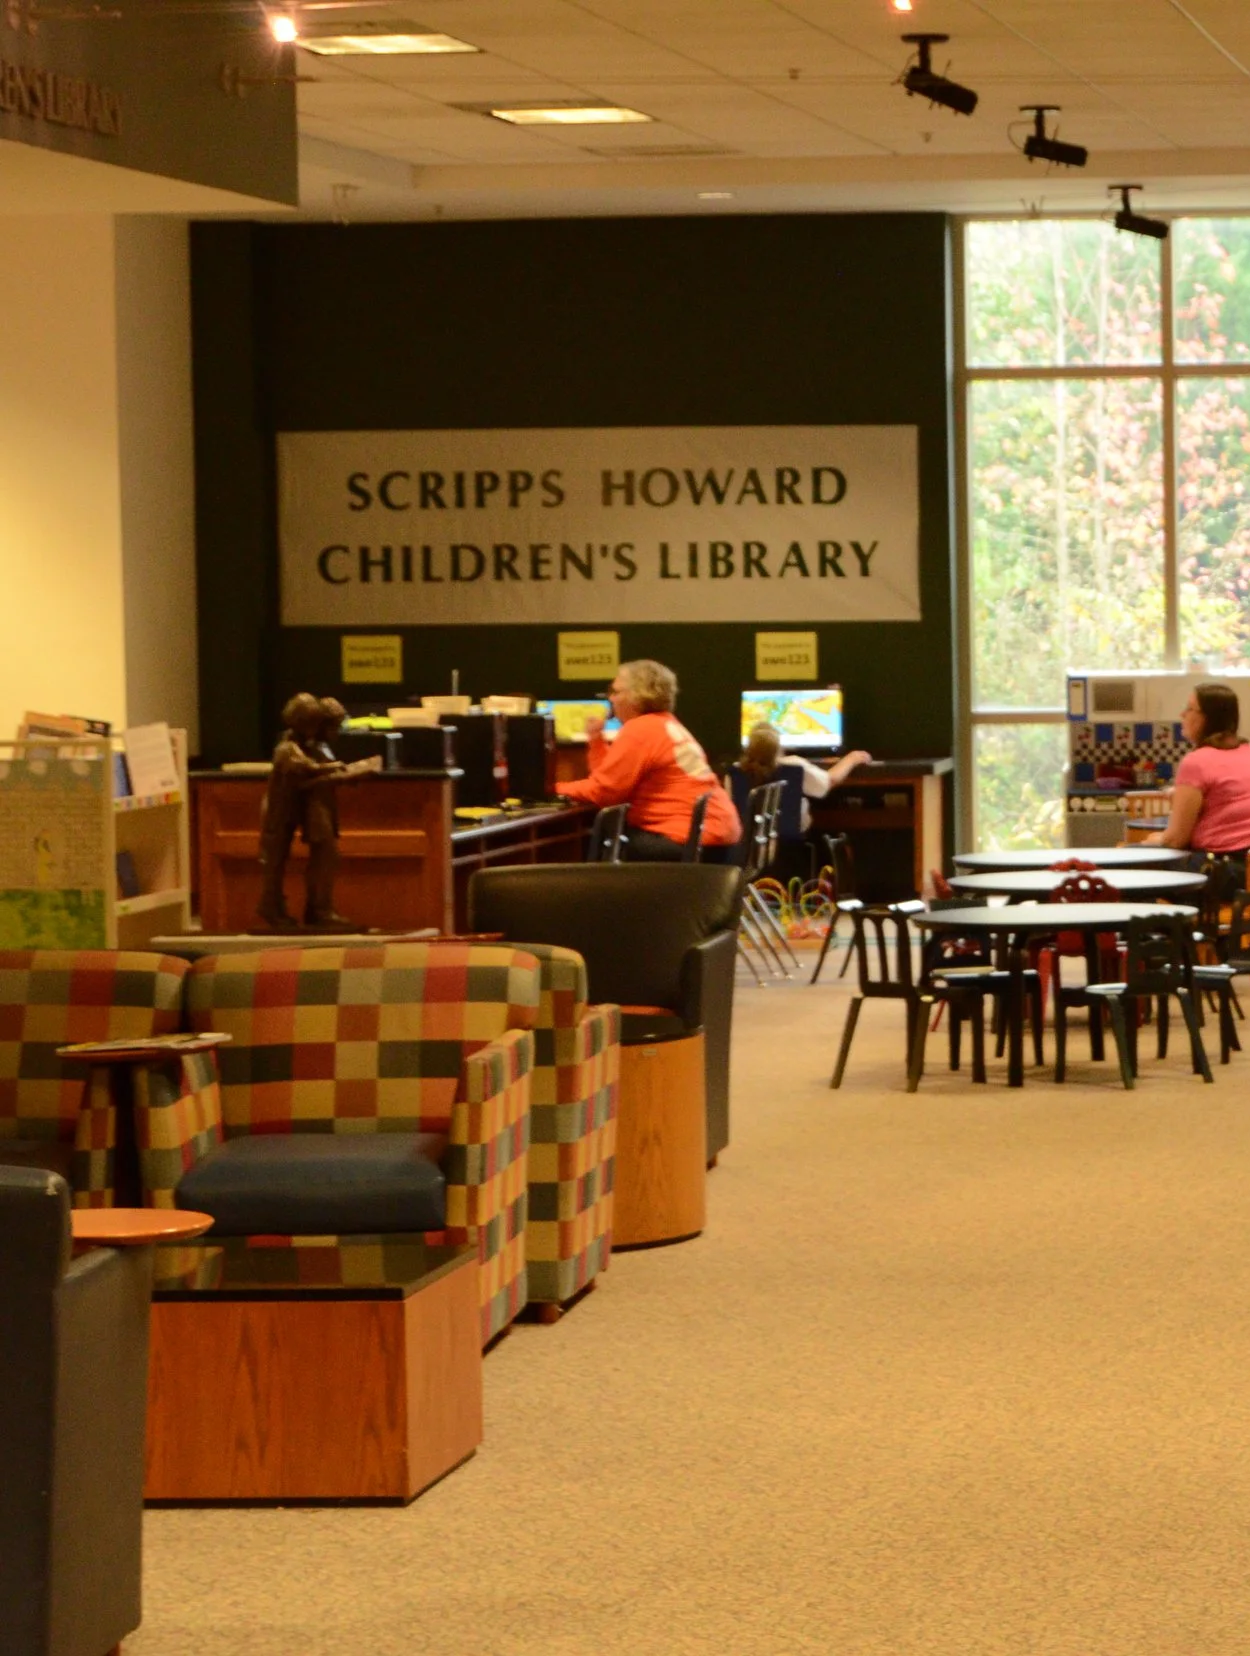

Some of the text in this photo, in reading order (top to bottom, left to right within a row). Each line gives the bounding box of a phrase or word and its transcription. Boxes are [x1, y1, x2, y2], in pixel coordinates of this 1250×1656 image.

[347, 466, 847, 511] SCRIPPS HOWARD
[317, 541, 878, 584] CHILDREN'S LIBRARY
